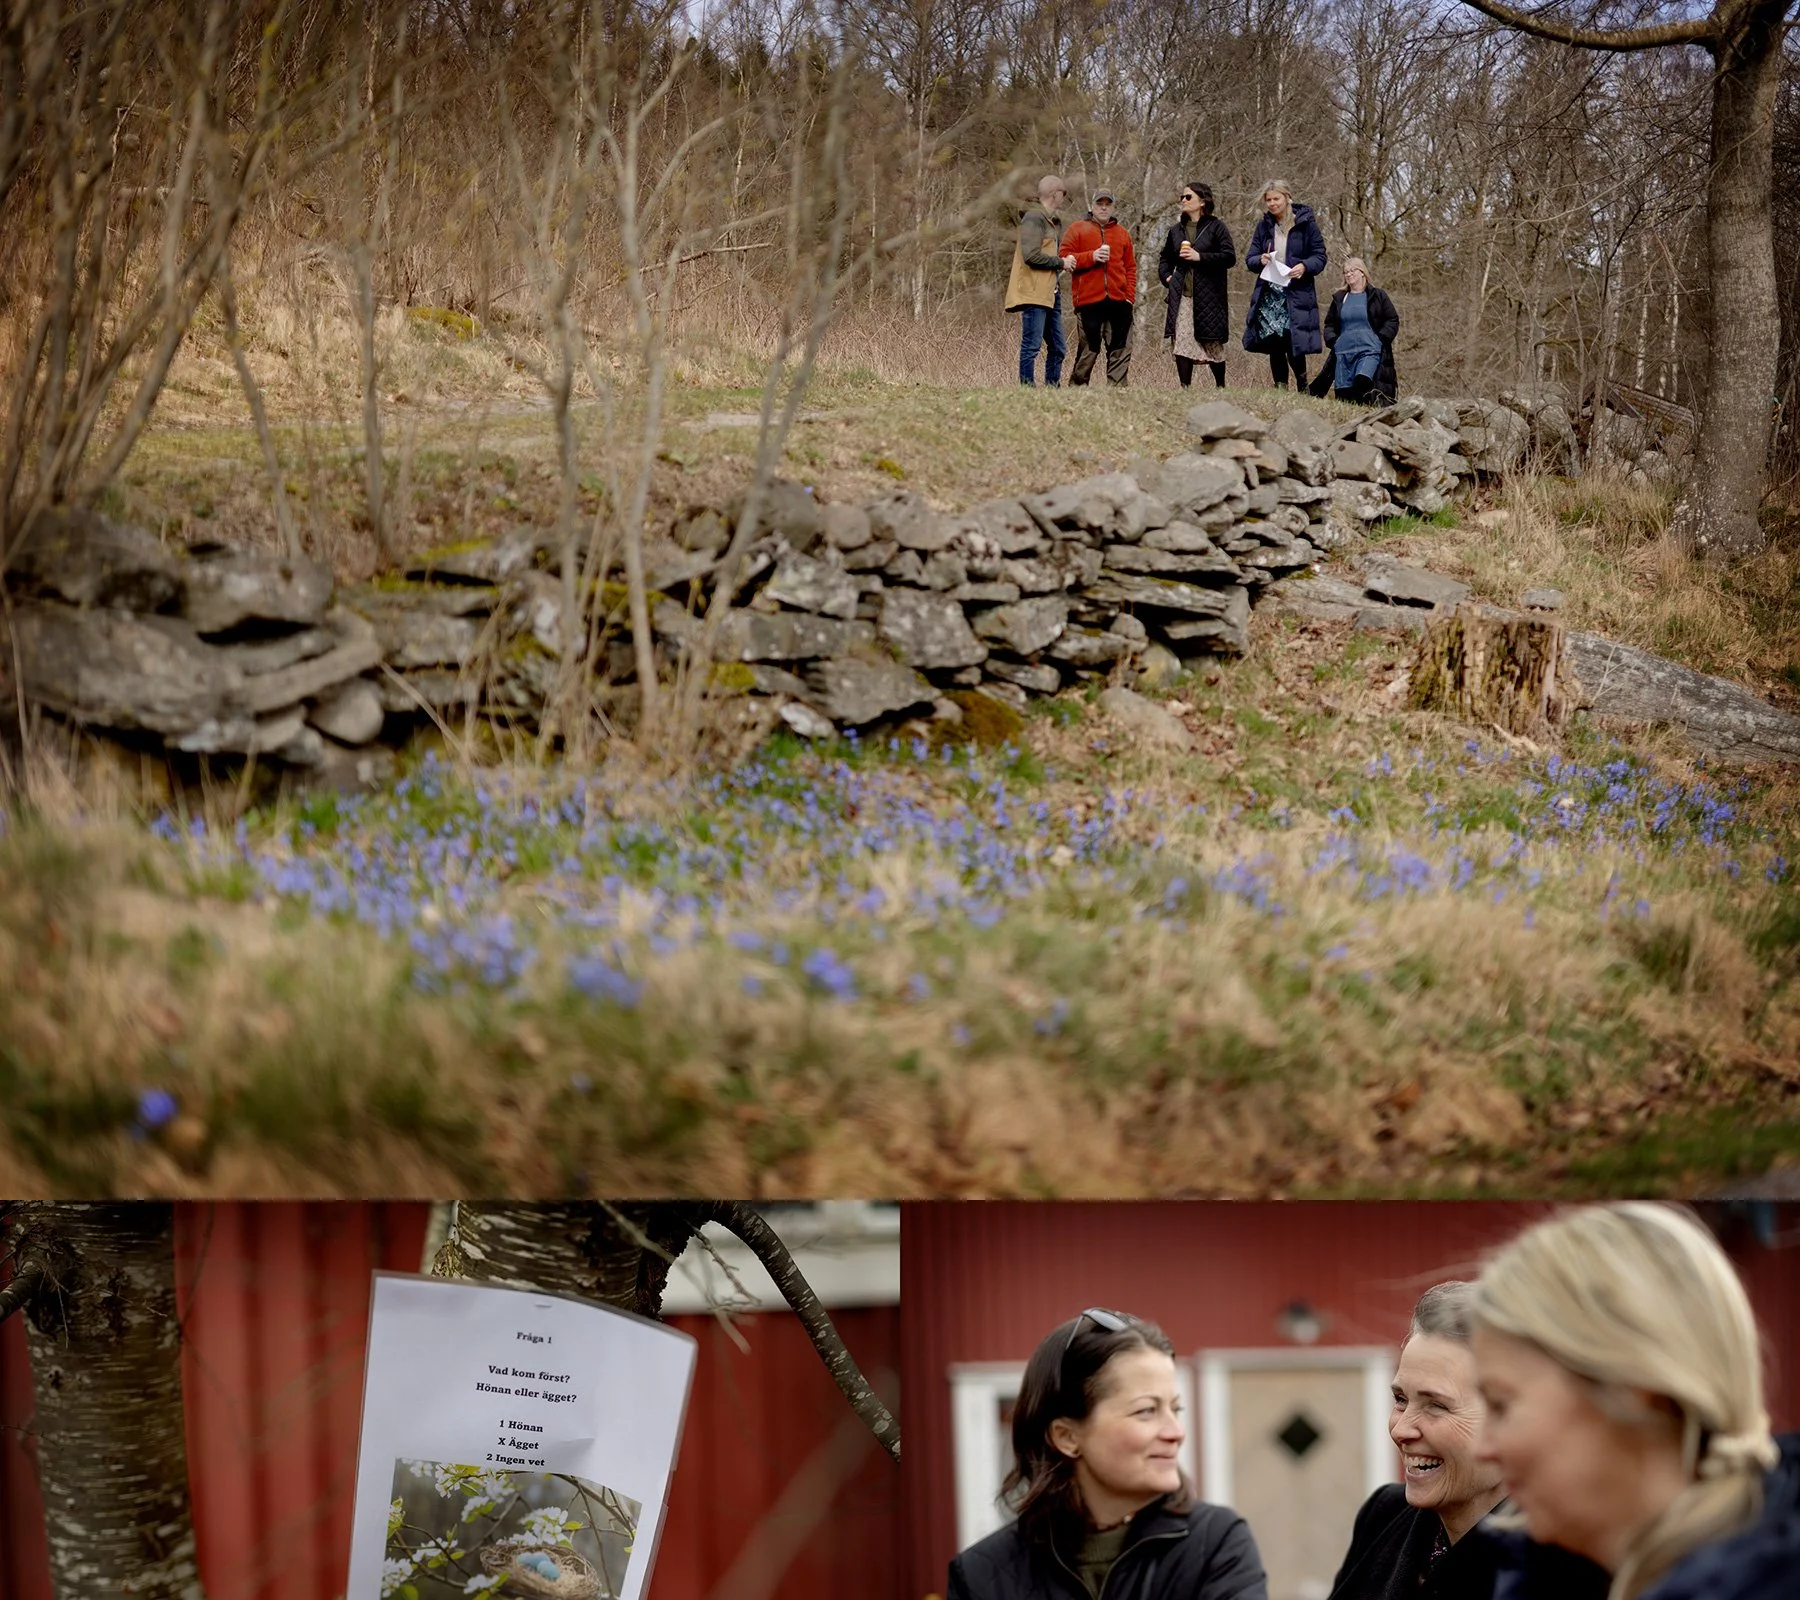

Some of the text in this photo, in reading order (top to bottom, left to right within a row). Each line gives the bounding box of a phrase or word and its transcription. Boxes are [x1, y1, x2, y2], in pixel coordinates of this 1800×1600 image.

[516, 1331, 552, 1344] Fråga 1
[488, 1365, 571, 1383] Vad kom först?
[476, 1382, 577, 1403] Hönan eller ägget?
[499, 1420, 544, 1433] 1 Hönan
[498, 1436, 540, 1451] X Ägget
[486, 1453, 545, 1467] 2 Ingen vet
